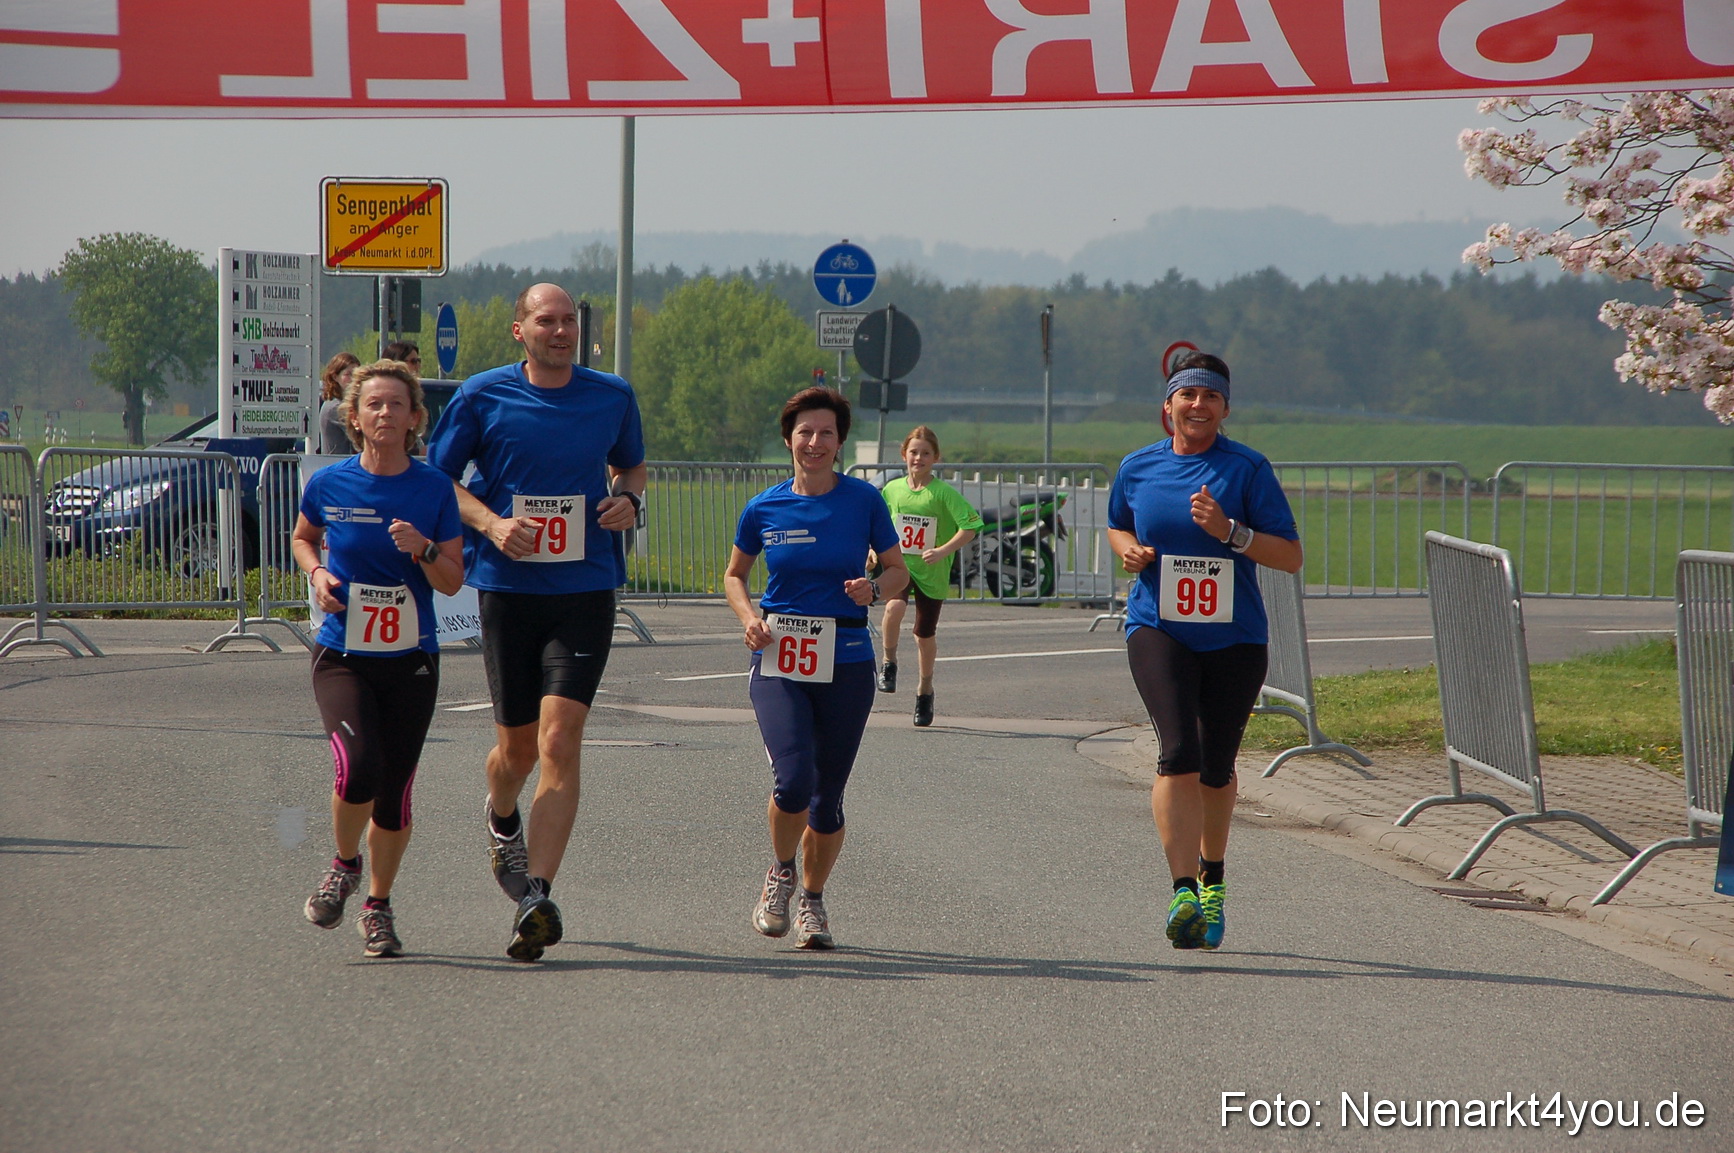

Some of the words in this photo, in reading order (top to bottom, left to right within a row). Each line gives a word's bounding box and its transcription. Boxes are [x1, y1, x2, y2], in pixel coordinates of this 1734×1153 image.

[336, 193, 432, 221] Sengenthal
[349, 224, 371, 235] am
[377, 222, 419, 238] Anger
[360, 246, 401, 258] Neumarkt
[263, 254, 300, 269] HOLZAMMER
[263, 285, 300, 300] HOLZAMMER
[242, 317, 262, 341] SHB
[823, 336, 851, 344] Verkehr
[241, 379, 273, 402] THULE
[242, 410, 299, 422] HEIDELBERGCEMENT
[524, 499, 558, 508] MEYER
[529, 516, 567, 555] 79
[902, 525, 925, 549] 34
[1173, 559, 1206, 568] MEYER
[1173, 567, 1207, 575] WERBUNG
[360, 588, 394, 599] MEYER
[1176, 577, 1218, 617] 99
[362, 605, 400, 643] 78
[776, 616, 809, 627] MEYER
[776, 625, 809, 634] WERBUNG
[777, 635, 818, 676] 65
